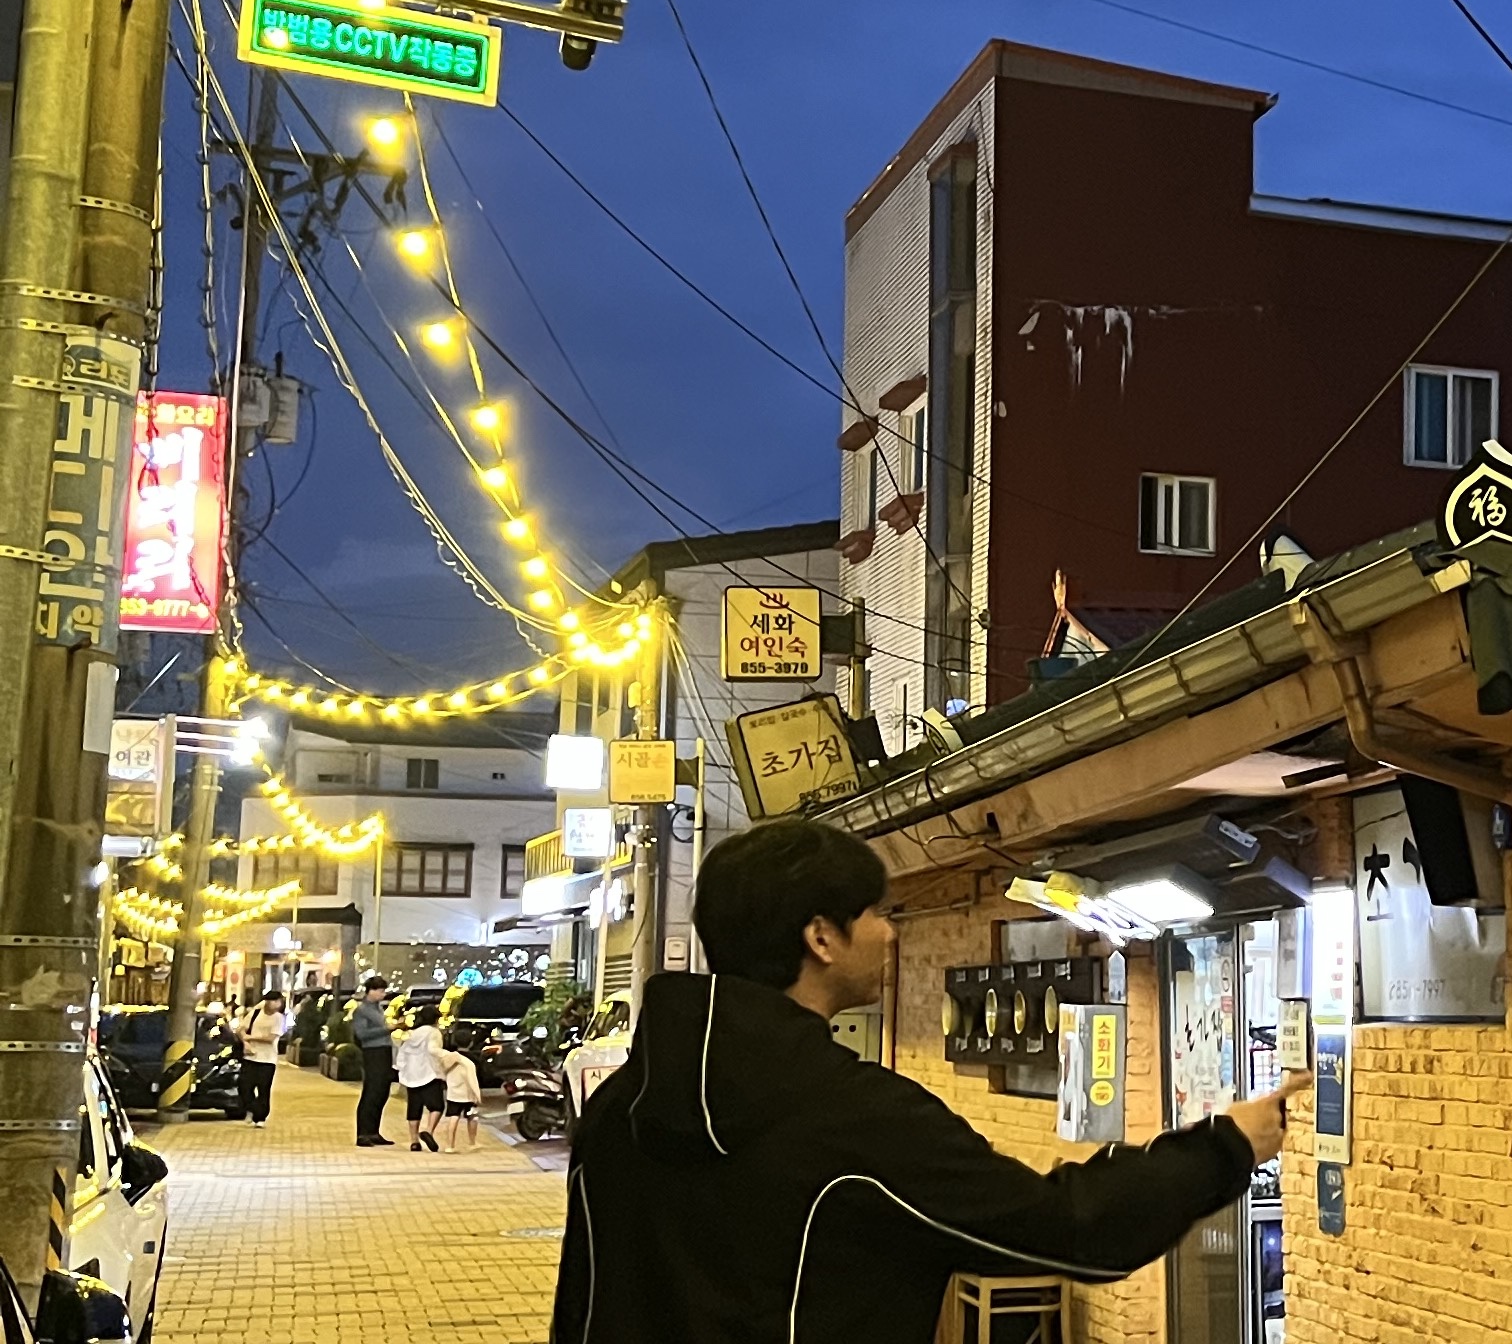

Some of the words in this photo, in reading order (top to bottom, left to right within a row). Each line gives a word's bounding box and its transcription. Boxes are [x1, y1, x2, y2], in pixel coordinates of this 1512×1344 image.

[1468, 485, 1507, 527] 福
[749, 613, 796, 636] 세화
[740, 636, 808, 659] 여인숙
[115, 749, 152, 766] 여관
[761, 735, 842, 778] 초가집
[1097, 1021, 1112, 1070] 소화기
